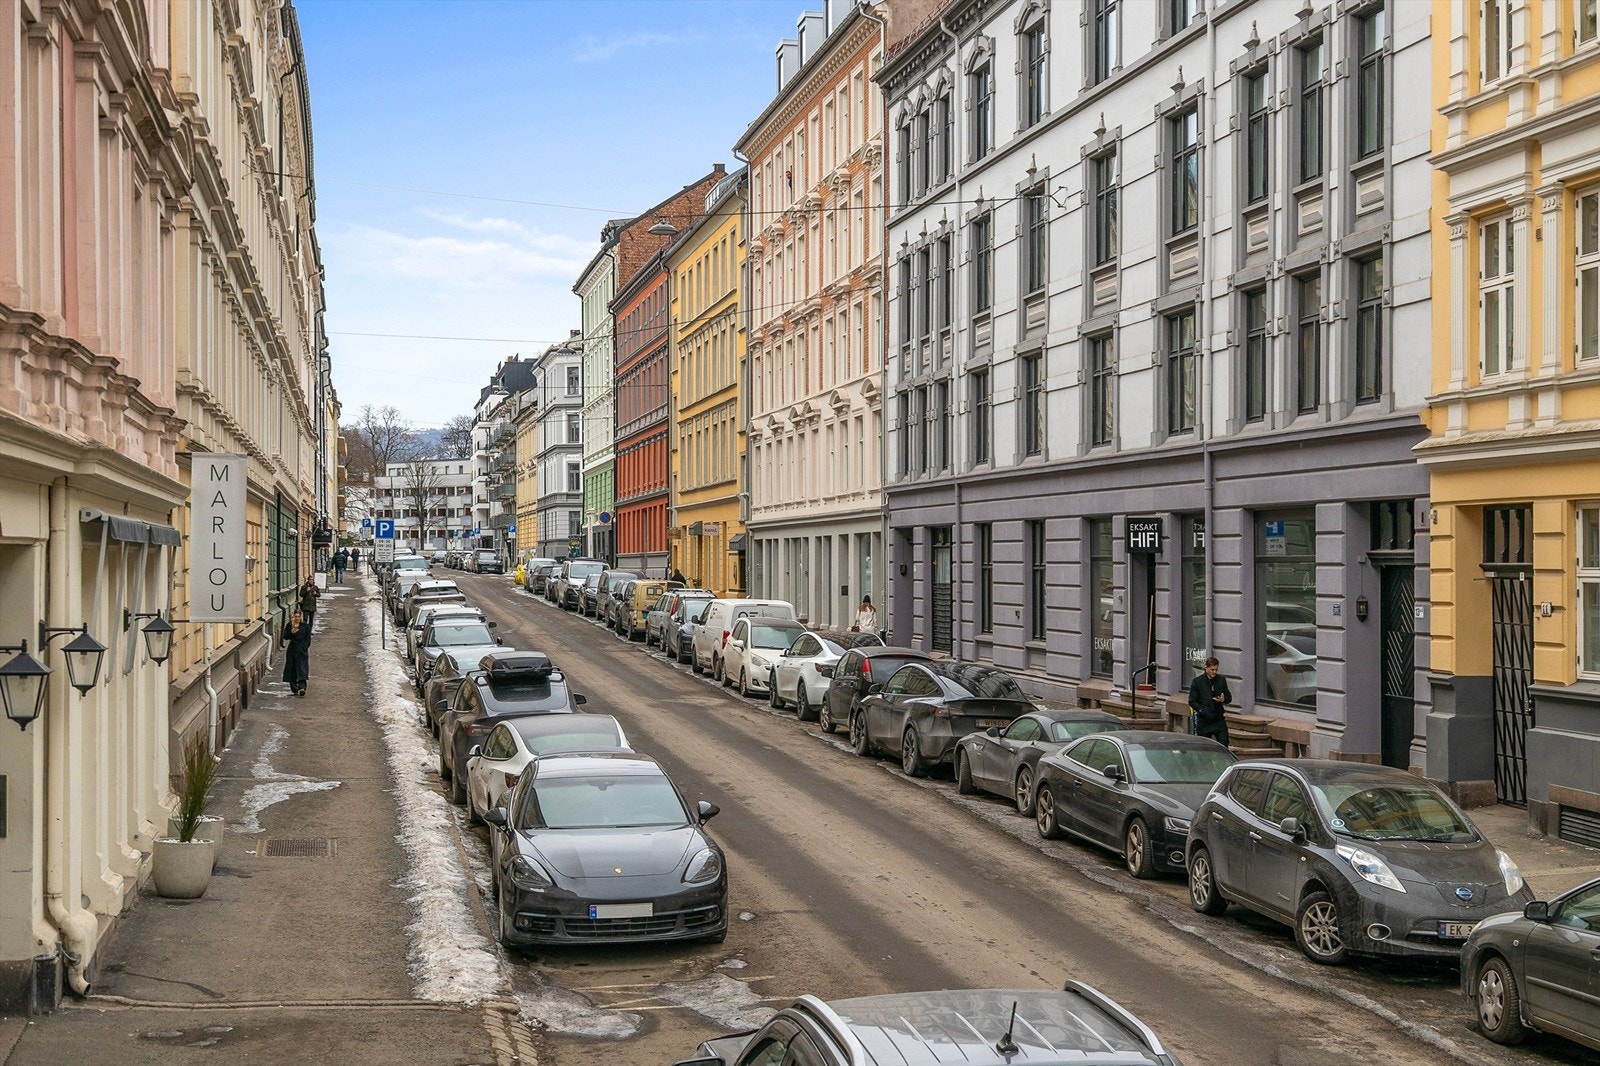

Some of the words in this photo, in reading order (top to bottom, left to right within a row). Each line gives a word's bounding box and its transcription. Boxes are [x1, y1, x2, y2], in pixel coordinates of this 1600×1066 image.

[379, 522, 390, 536] P
[1129, 523, 1158, 531] EKSAKT
[209, 464, 228, 612] MARLOU
[1130, 532, 1158, 548] HIFI
[1449, 925, 1462, 936] EK
